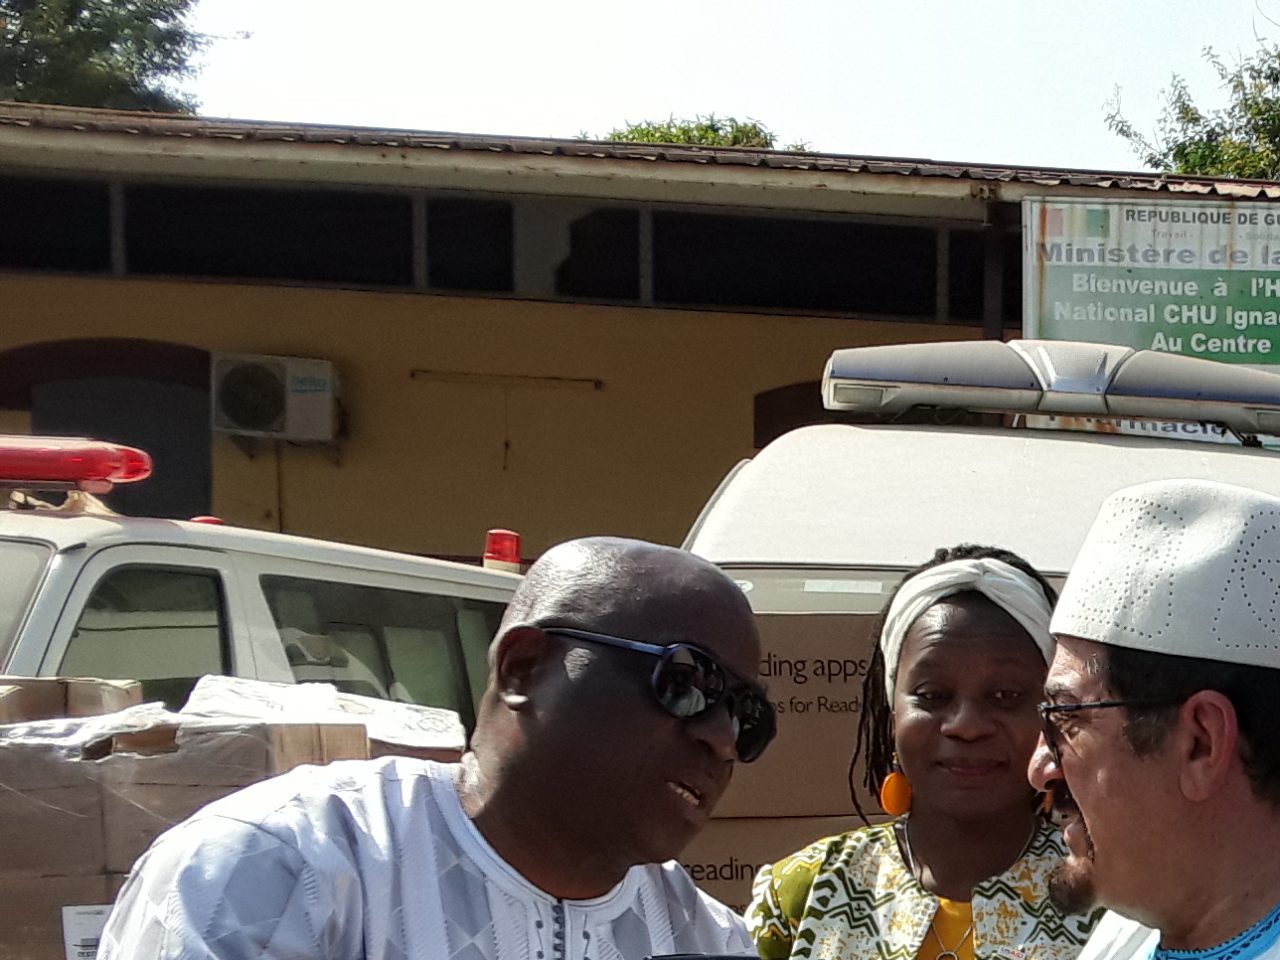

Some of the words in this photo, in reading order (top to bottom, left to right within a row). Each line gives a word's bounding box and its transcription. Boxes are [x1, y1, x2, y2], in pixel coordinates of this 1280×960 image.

[1125, 208, 1232, 225] REPUBLIQUE
[1237, 212, 1259, 226] DE
[1038, 241, 1196, 265] Ministère
[1208, 242, 1248, 265] de
[1072, 273, 1199, 297] Bienvenue
[1213, 277, 1228, 298] à
[1054, 301, 1156, 323] National
[1163, 303, 1217, 326] CHU
[1151, 332, 1183, 353] Au
[1190, 332, 1272, 354] Centre
[813, 659, 867, 683] apps
[789, 696, 814, 714] for
